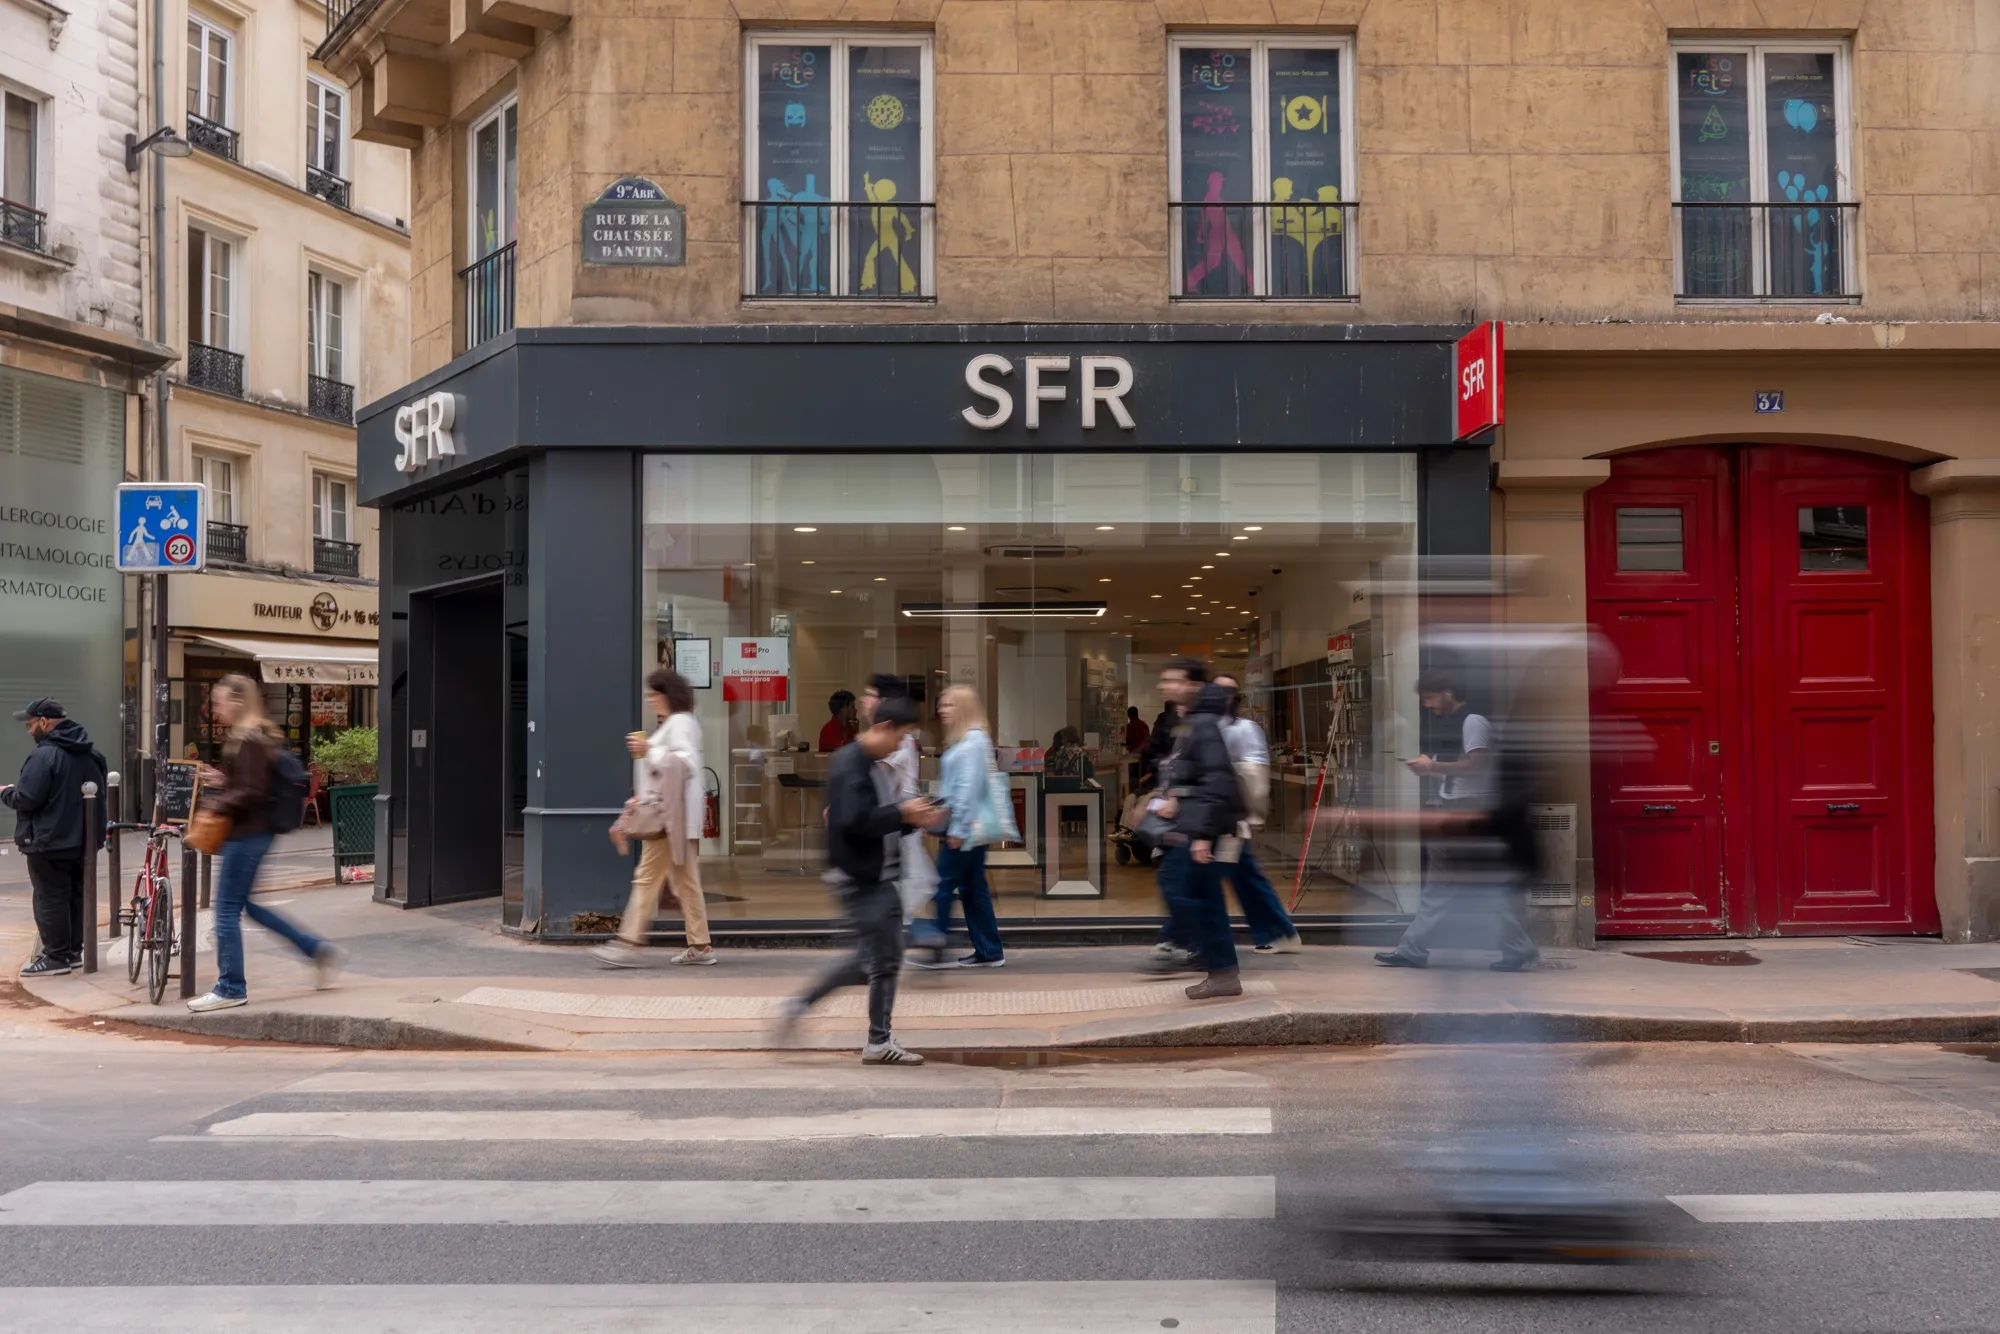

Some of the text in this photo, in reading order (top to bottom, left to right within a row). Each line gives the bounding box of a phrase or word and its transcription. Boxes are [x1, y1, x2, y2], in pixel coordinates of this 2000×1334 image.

[1211, 51, 1235, 67] so
[1709, 58, 1731, 72] so
[1192, 65, 1235, 86] fête
[1690, 69, 1732, 90] fête
[596, 214, 671, 226] RUE DE LA
[593, 227, 673, 242] CHAUSSÉE
[1462, 358, 1485, 401] SFR
[961, 353, 1137, 430] SFR
[1758, 392, 1781, 410] 37
[394, 391, 456, 473] SFR
[0, 506, 106, 534] LERGOLOGIE
[171, 544, 188, 555] 20
[0, 578, 107, 603] RMATOLOGIE
[253, 602, 303, 620] TRAITEUR
[744, 646, 757, 654] SFR
[347, 669, 379, 681] jiah
[731, 668, 742, 676] ici,
[754, 676, 771, 684] pros
